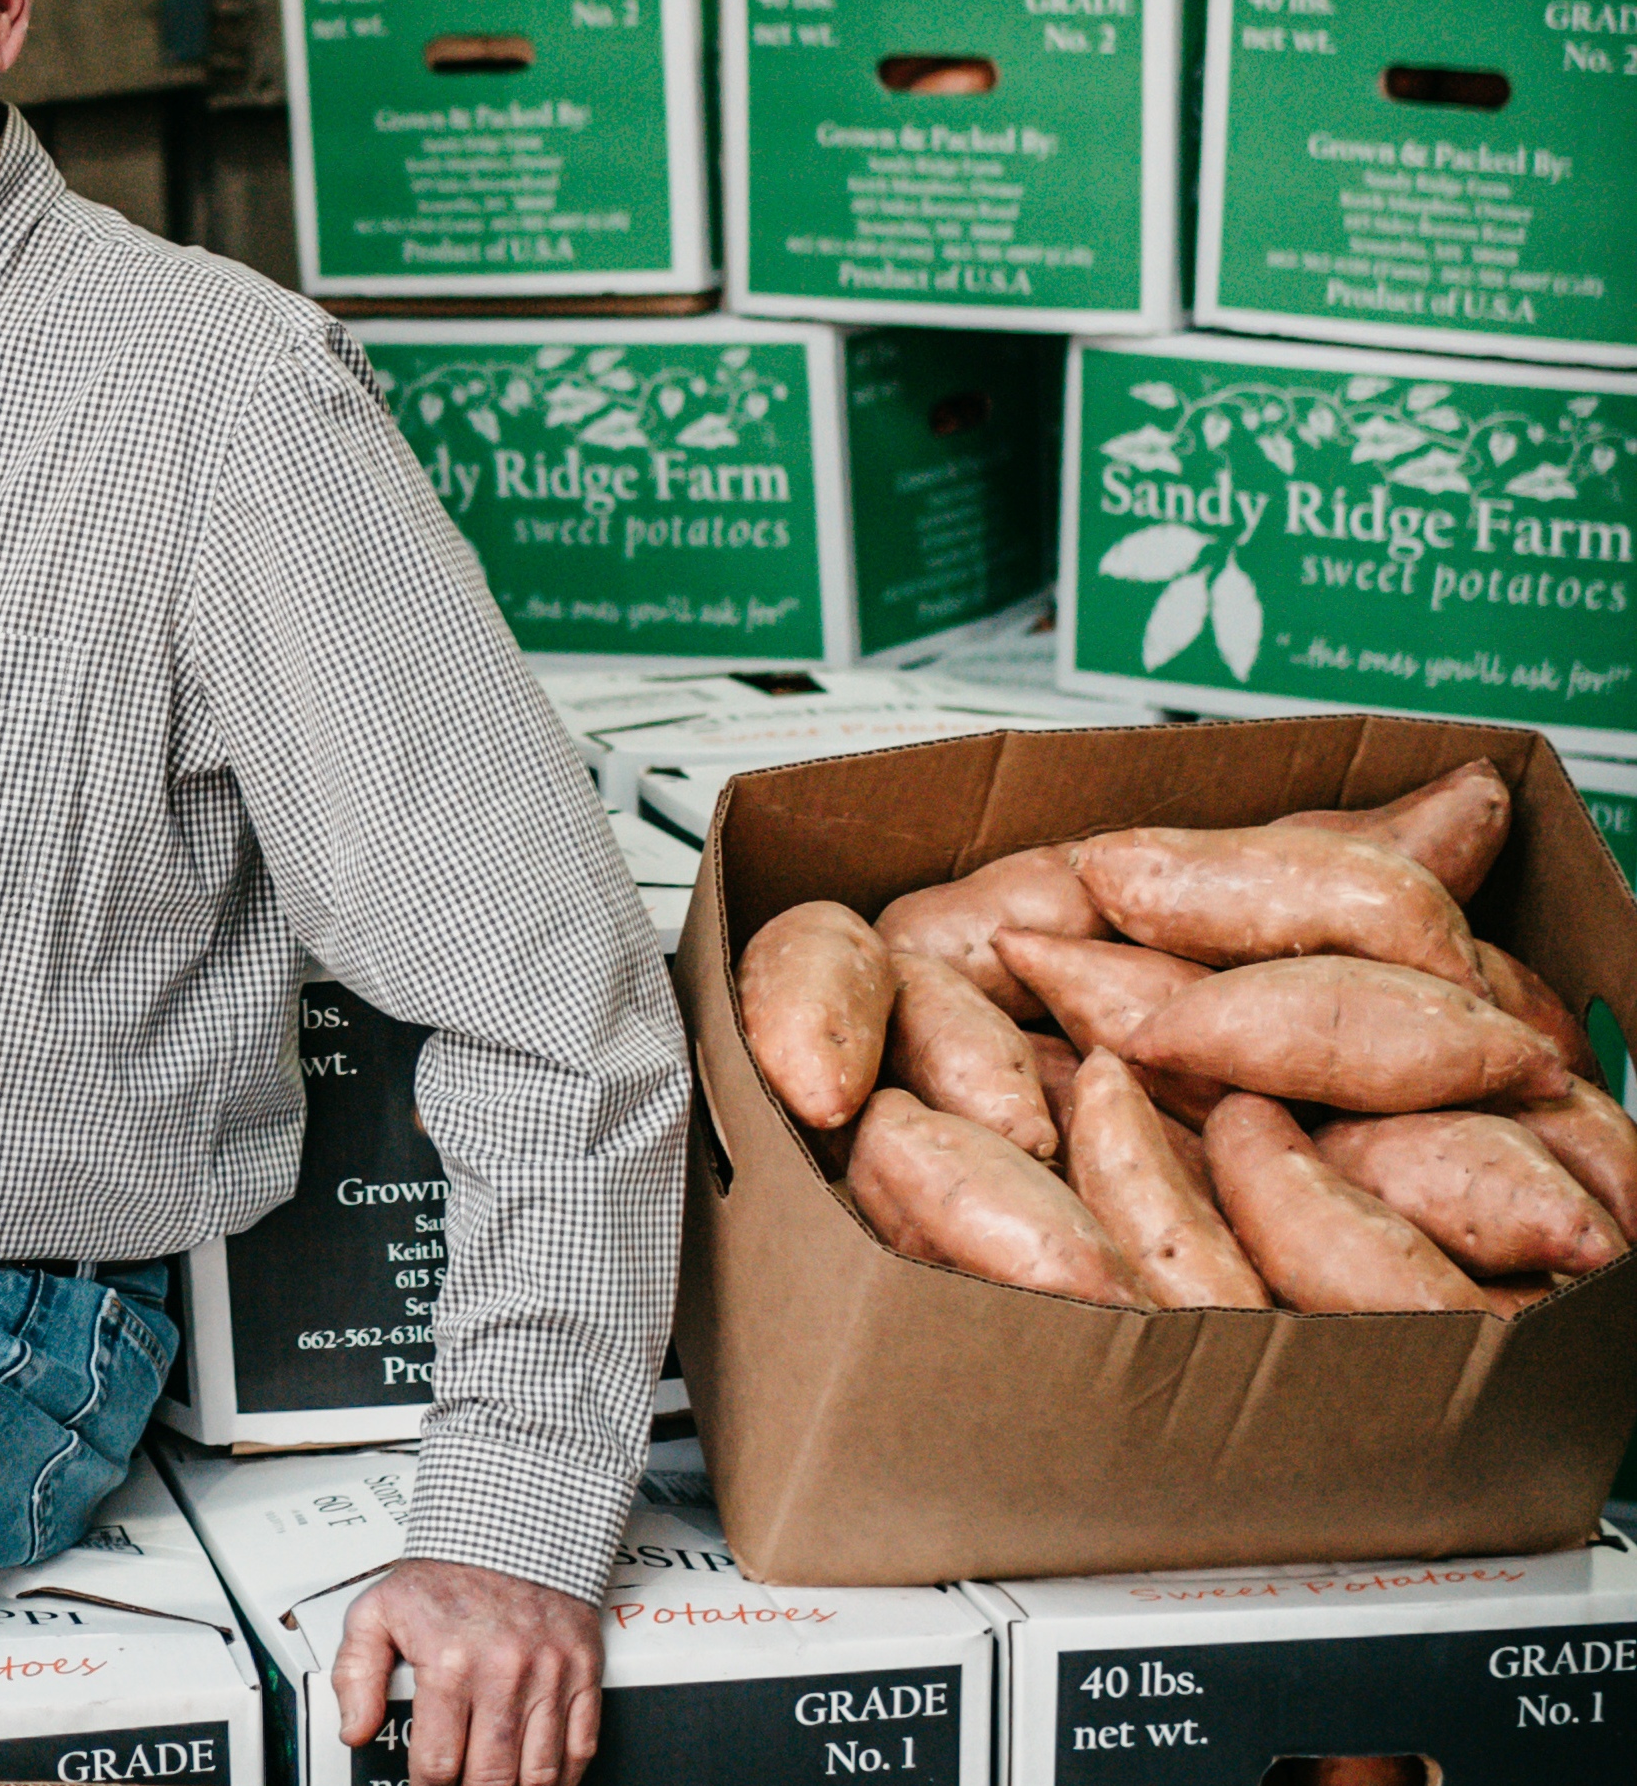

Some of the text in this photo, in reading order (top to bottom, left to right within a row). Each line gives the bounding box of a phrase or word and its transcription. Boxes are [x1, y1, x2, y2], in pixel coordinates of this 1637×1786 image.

[1544, 0, 1637, 34] GRAD
[1044, 22, 1117, 55] No. 2
[1242, 25, 1337, 54] net wt.
[1563, 40, 1613, 72] No.
[1307, 131, 1396, 166] Grown
[1434, 140, 1527, 176] Packed
[495, 448, 639, 513] Ridge
[653, 450, 792, 503] Farm
[1101, 465, 1633, 564] Sandy Ridge Farm
[513, 513, 792, 559] sweet potatoes
[1300, 555, 1629, 613] sweet potatoes
[301, 998, 350, 1030] bs.
[336, 1177, 451, 1207] Grown
[387, 1241, 444, 1263] Keith
[394, 1267, 430, 1289] 615
[364, 1474, 406, 1508] Store
[328, 1514, 367, 1526] F
[1129, 1562, 1529, 1605] Sweet Potatoes
[608, 1600, 839, 1631] Potatoes
[1487, 1639, 1637, 1678] GRADE
[1079, 1660, 1205, 1699] 40 lbs.
[793, 1682, 950, 1729] GRADE
[1516, 1691, 1605, 1729] No. 1
[1073, 1716, 1209, 1751] net wt.
[56, 1738, 218, 1786] GRADE
[823, 1737, 917, 1777] No. 1
